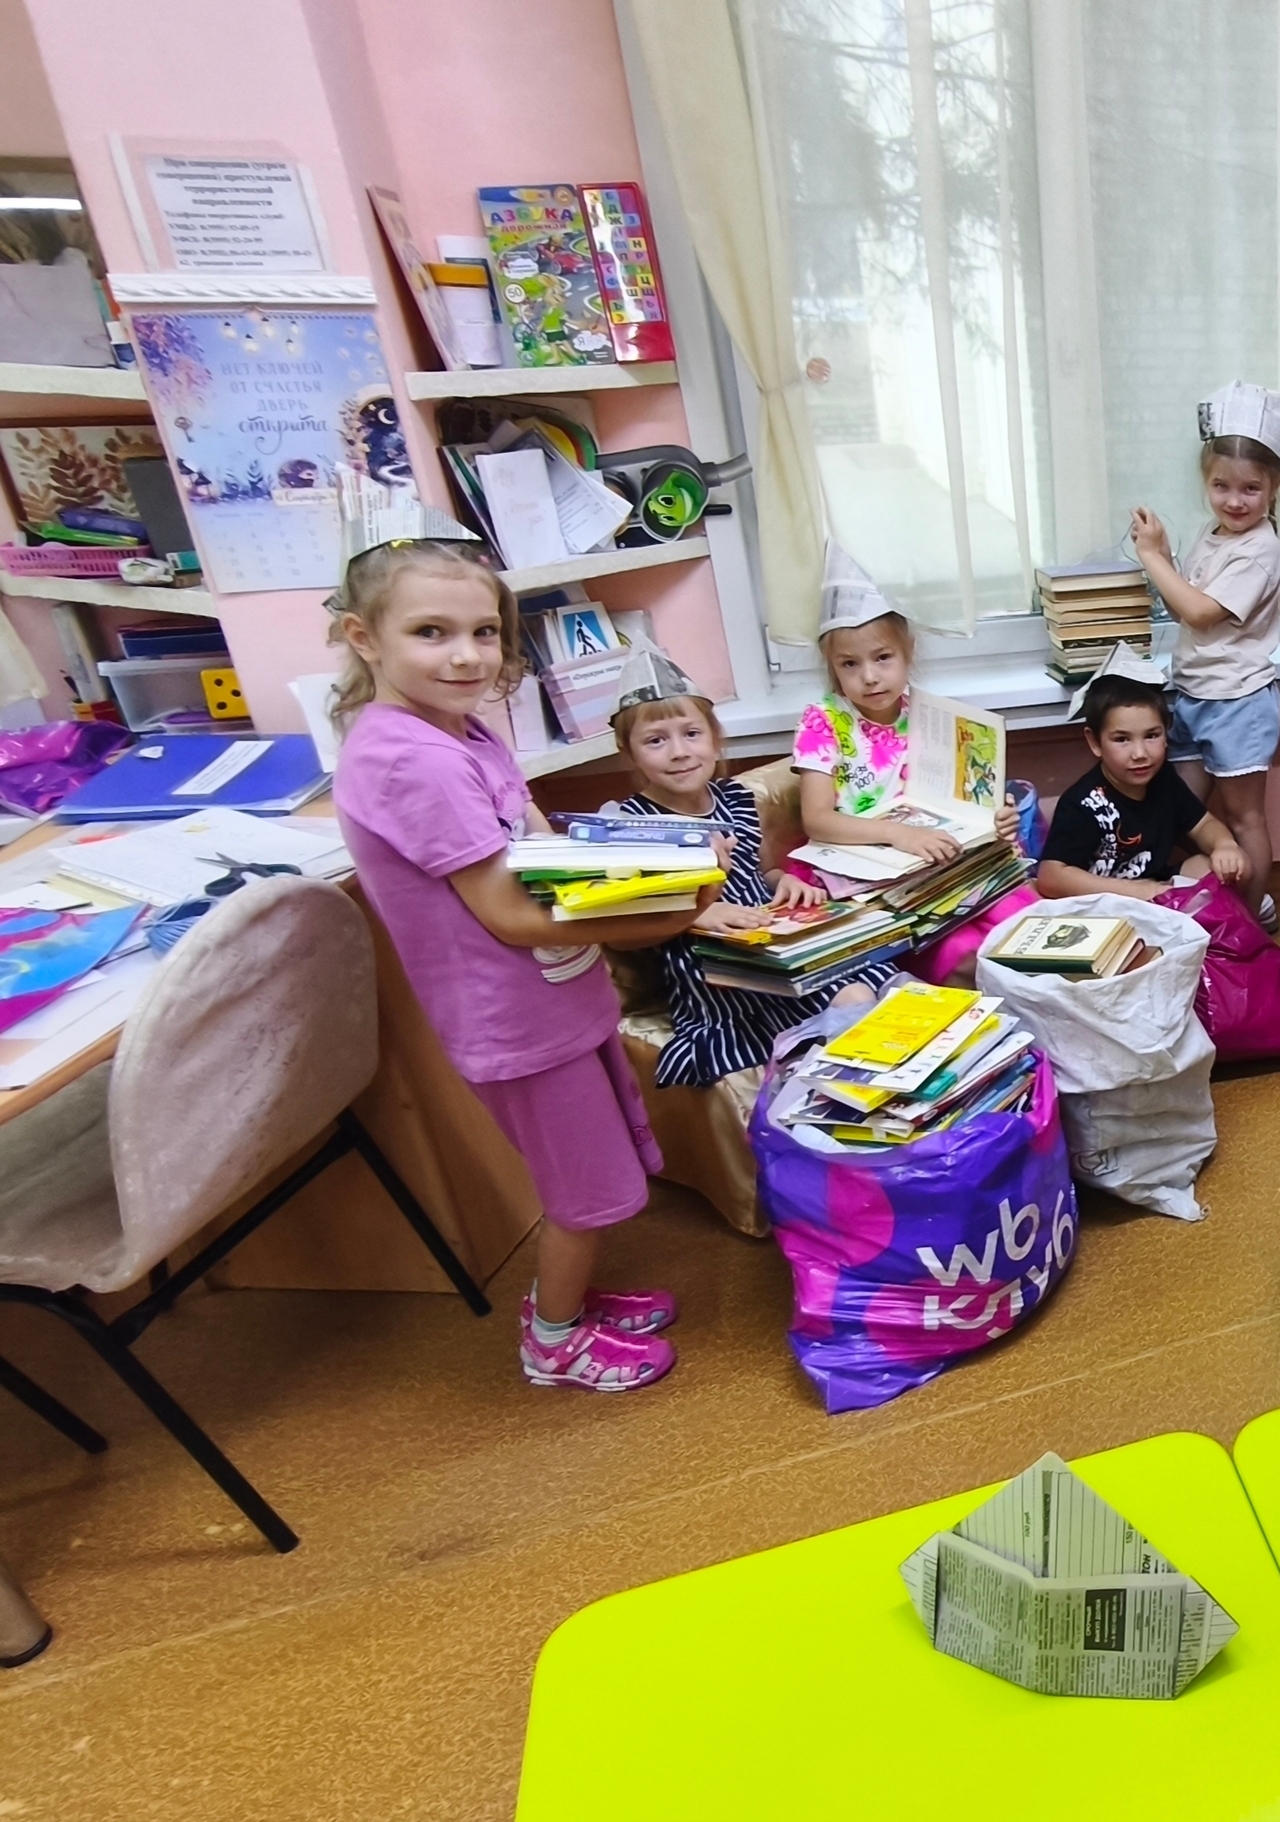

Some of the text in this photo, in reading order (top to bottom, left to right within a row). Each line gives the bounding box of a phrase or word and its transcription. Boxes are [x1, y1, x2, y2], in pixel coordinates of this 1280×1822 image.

[608, 204, 619, 214] Д
[491, 208, 574, 224] АЗБУКА
[610, 217, 623, 225] Ж
[633, 240, 642, 248] Н
[640, 276, 651, 286] Ц
[508, 287, 522, 298] 50
[220, 361, 324, 375] НЕТ КЛЮЧЕЙ
[230, 381, 322, 394] ОТ СЧАСТЬЯ
[257, 400, 308, 413] ДВЕРЬ
[238, 415, 328, 455] открыта
[916, 1197, 1040, 1287] wb
